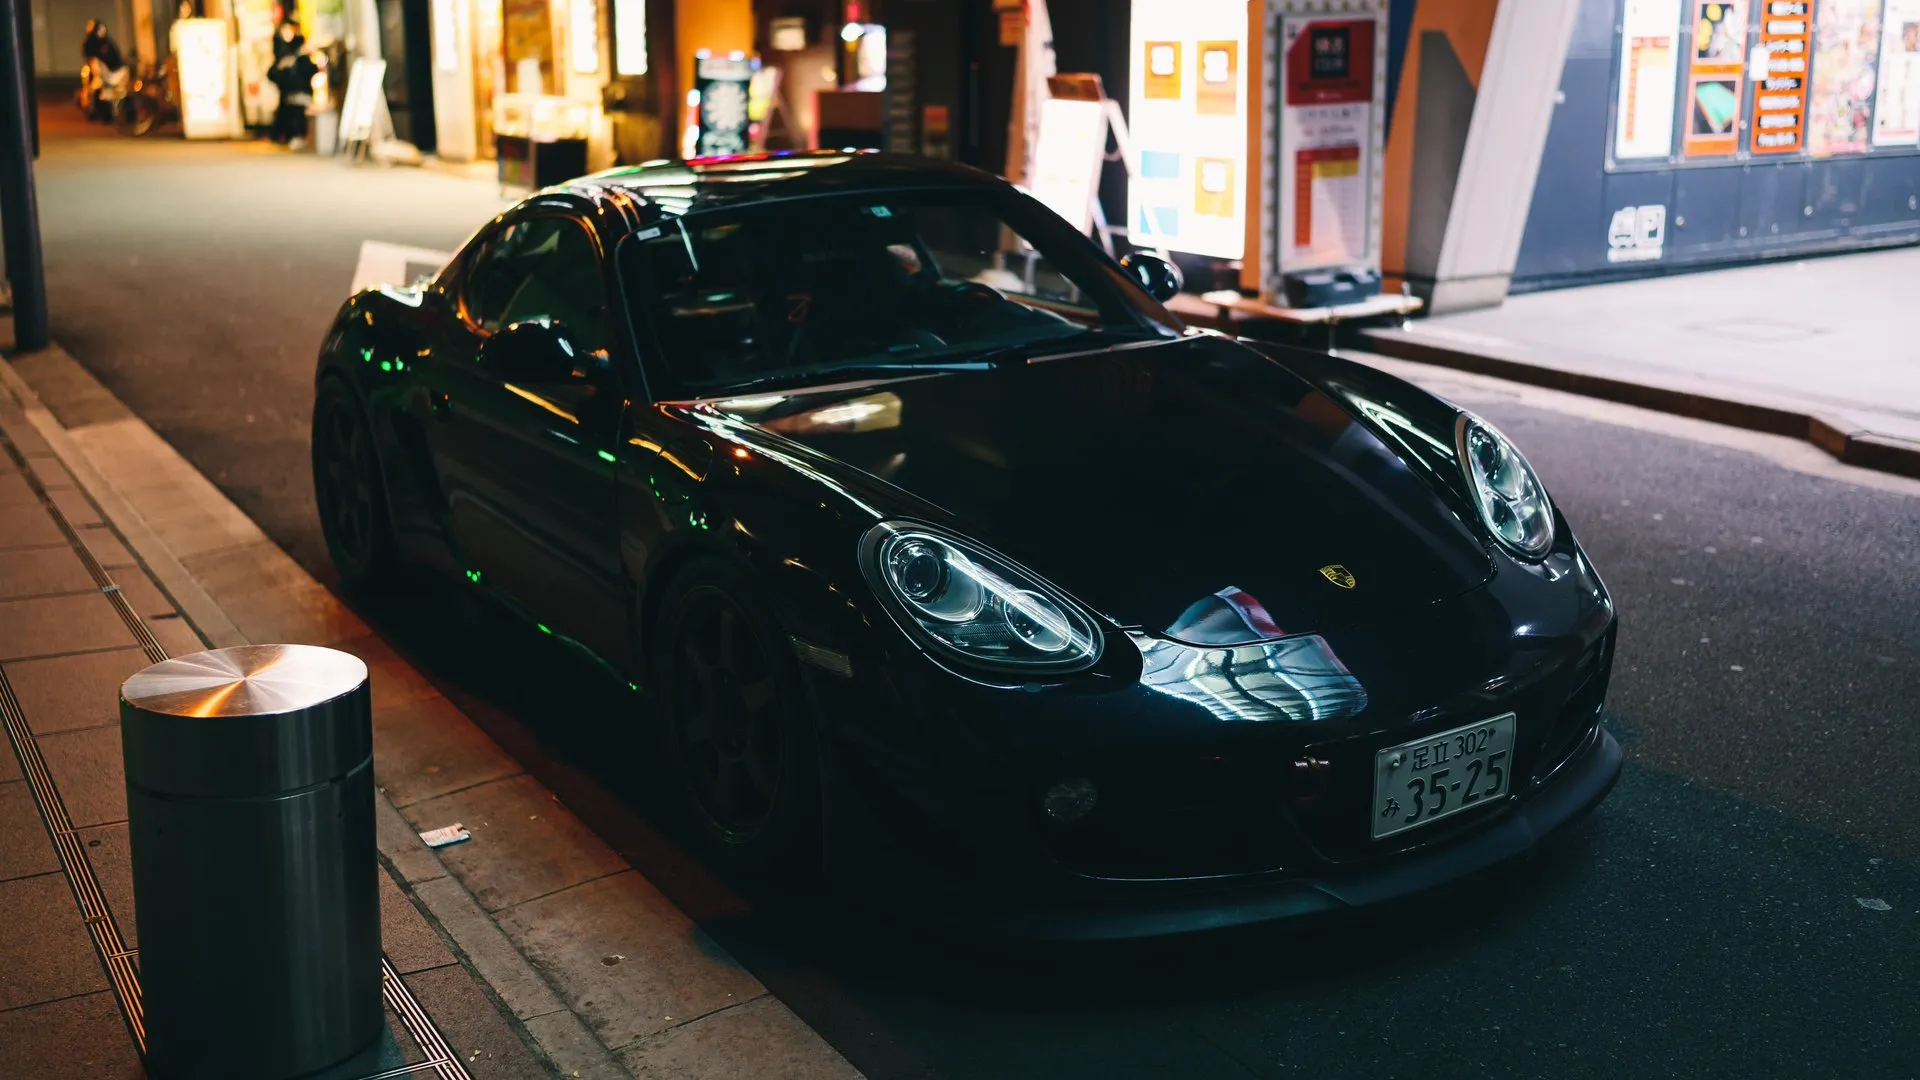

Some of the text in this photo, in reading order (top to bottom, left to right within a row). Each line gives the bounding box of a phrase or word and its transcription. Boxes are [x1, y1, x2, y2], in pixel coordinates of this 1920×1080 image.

[1411, 728, 1488, 772] 足立 302
[1381, 750, 1507, 823] み 35-25
